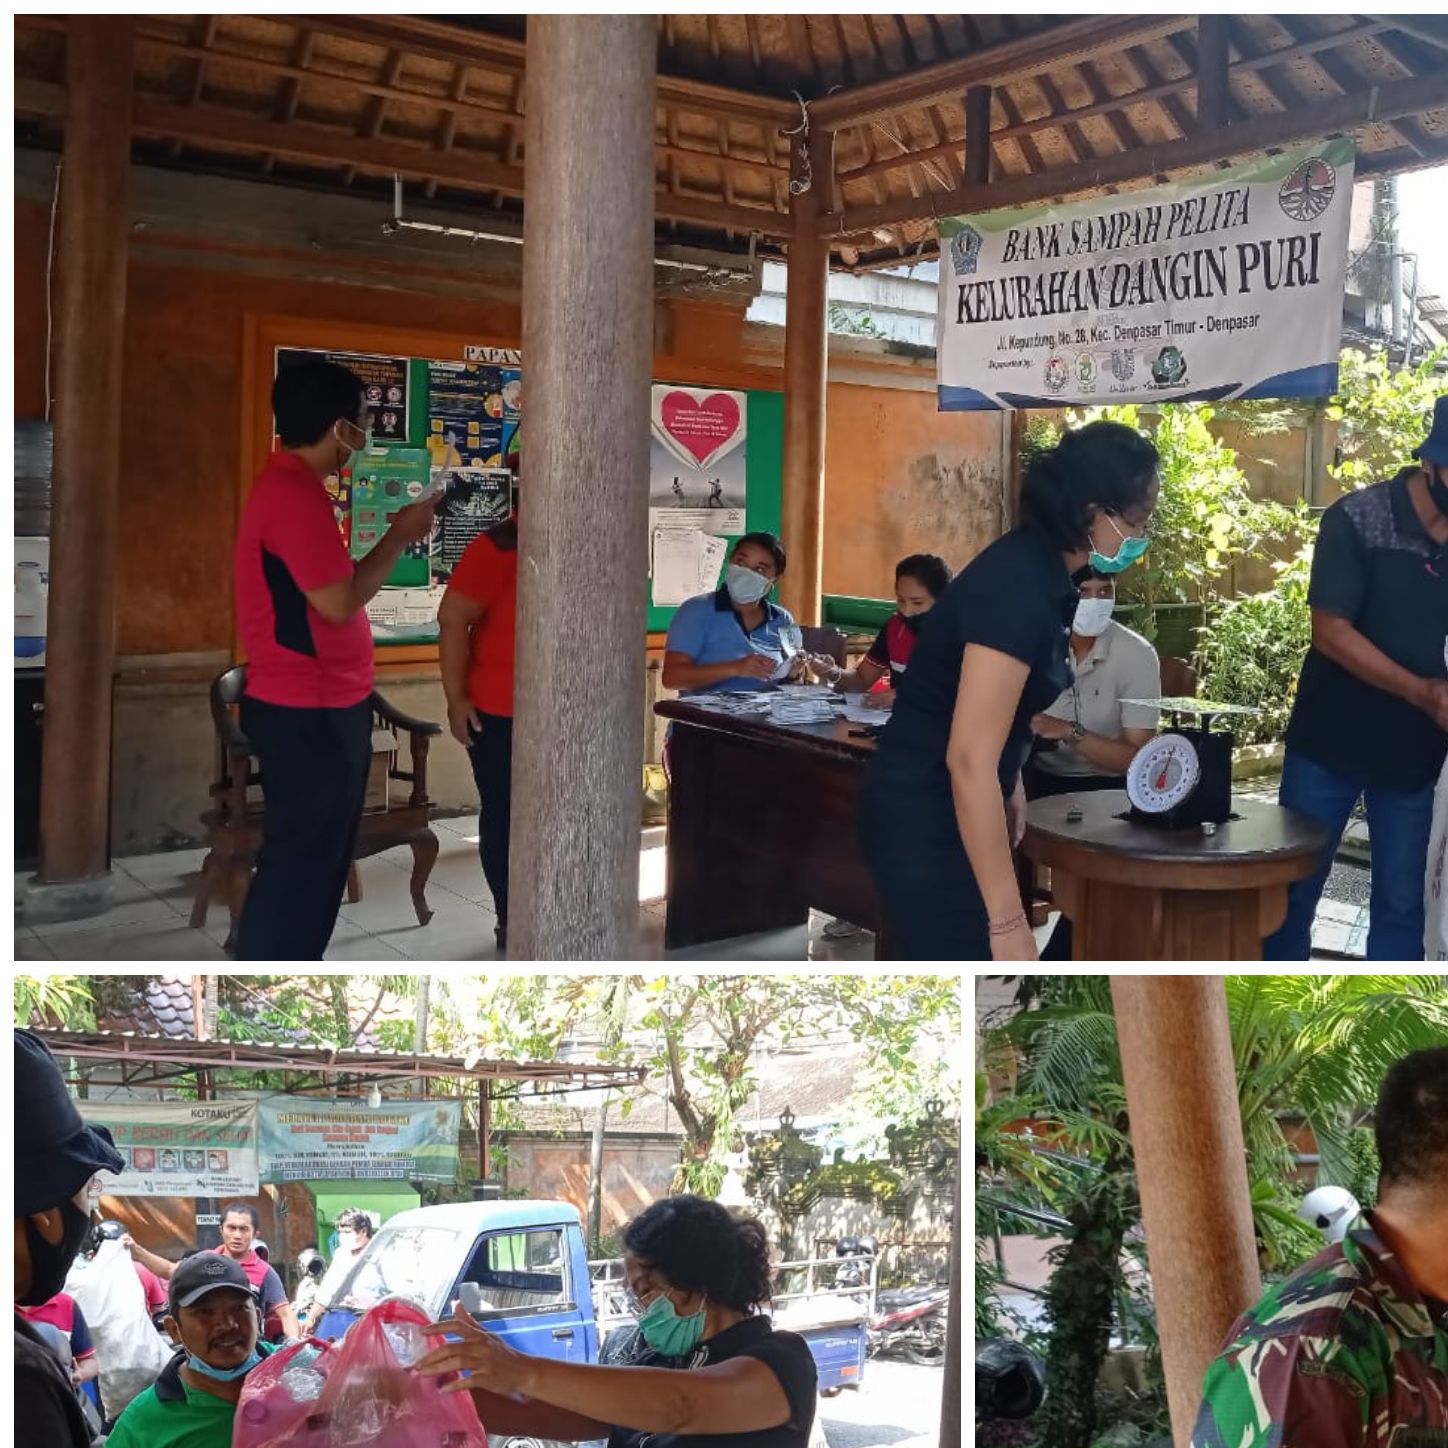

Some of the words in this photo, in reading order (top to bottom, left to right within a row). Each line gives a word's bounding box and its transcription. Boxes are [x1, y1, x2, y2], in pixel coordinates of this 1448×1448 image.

[1001, 221, 1064, 263] BANK
[1066, 206, 1162, 255] SAMPAH
[1165, 187, 1250, 240] PELITA
[956, 263, 1107, 324] KELURAHAN
[1109, 246, 1227, 308] DANGIN
[1236, 232, 1322, 293] PURI
[1091, 327, 1111, 343] Kec.
[1114, 323, 1162, 342] Denpasar
[1166, 318, 1196, 335] Timur
[1206, 313, 1261, 333] Denpasar
